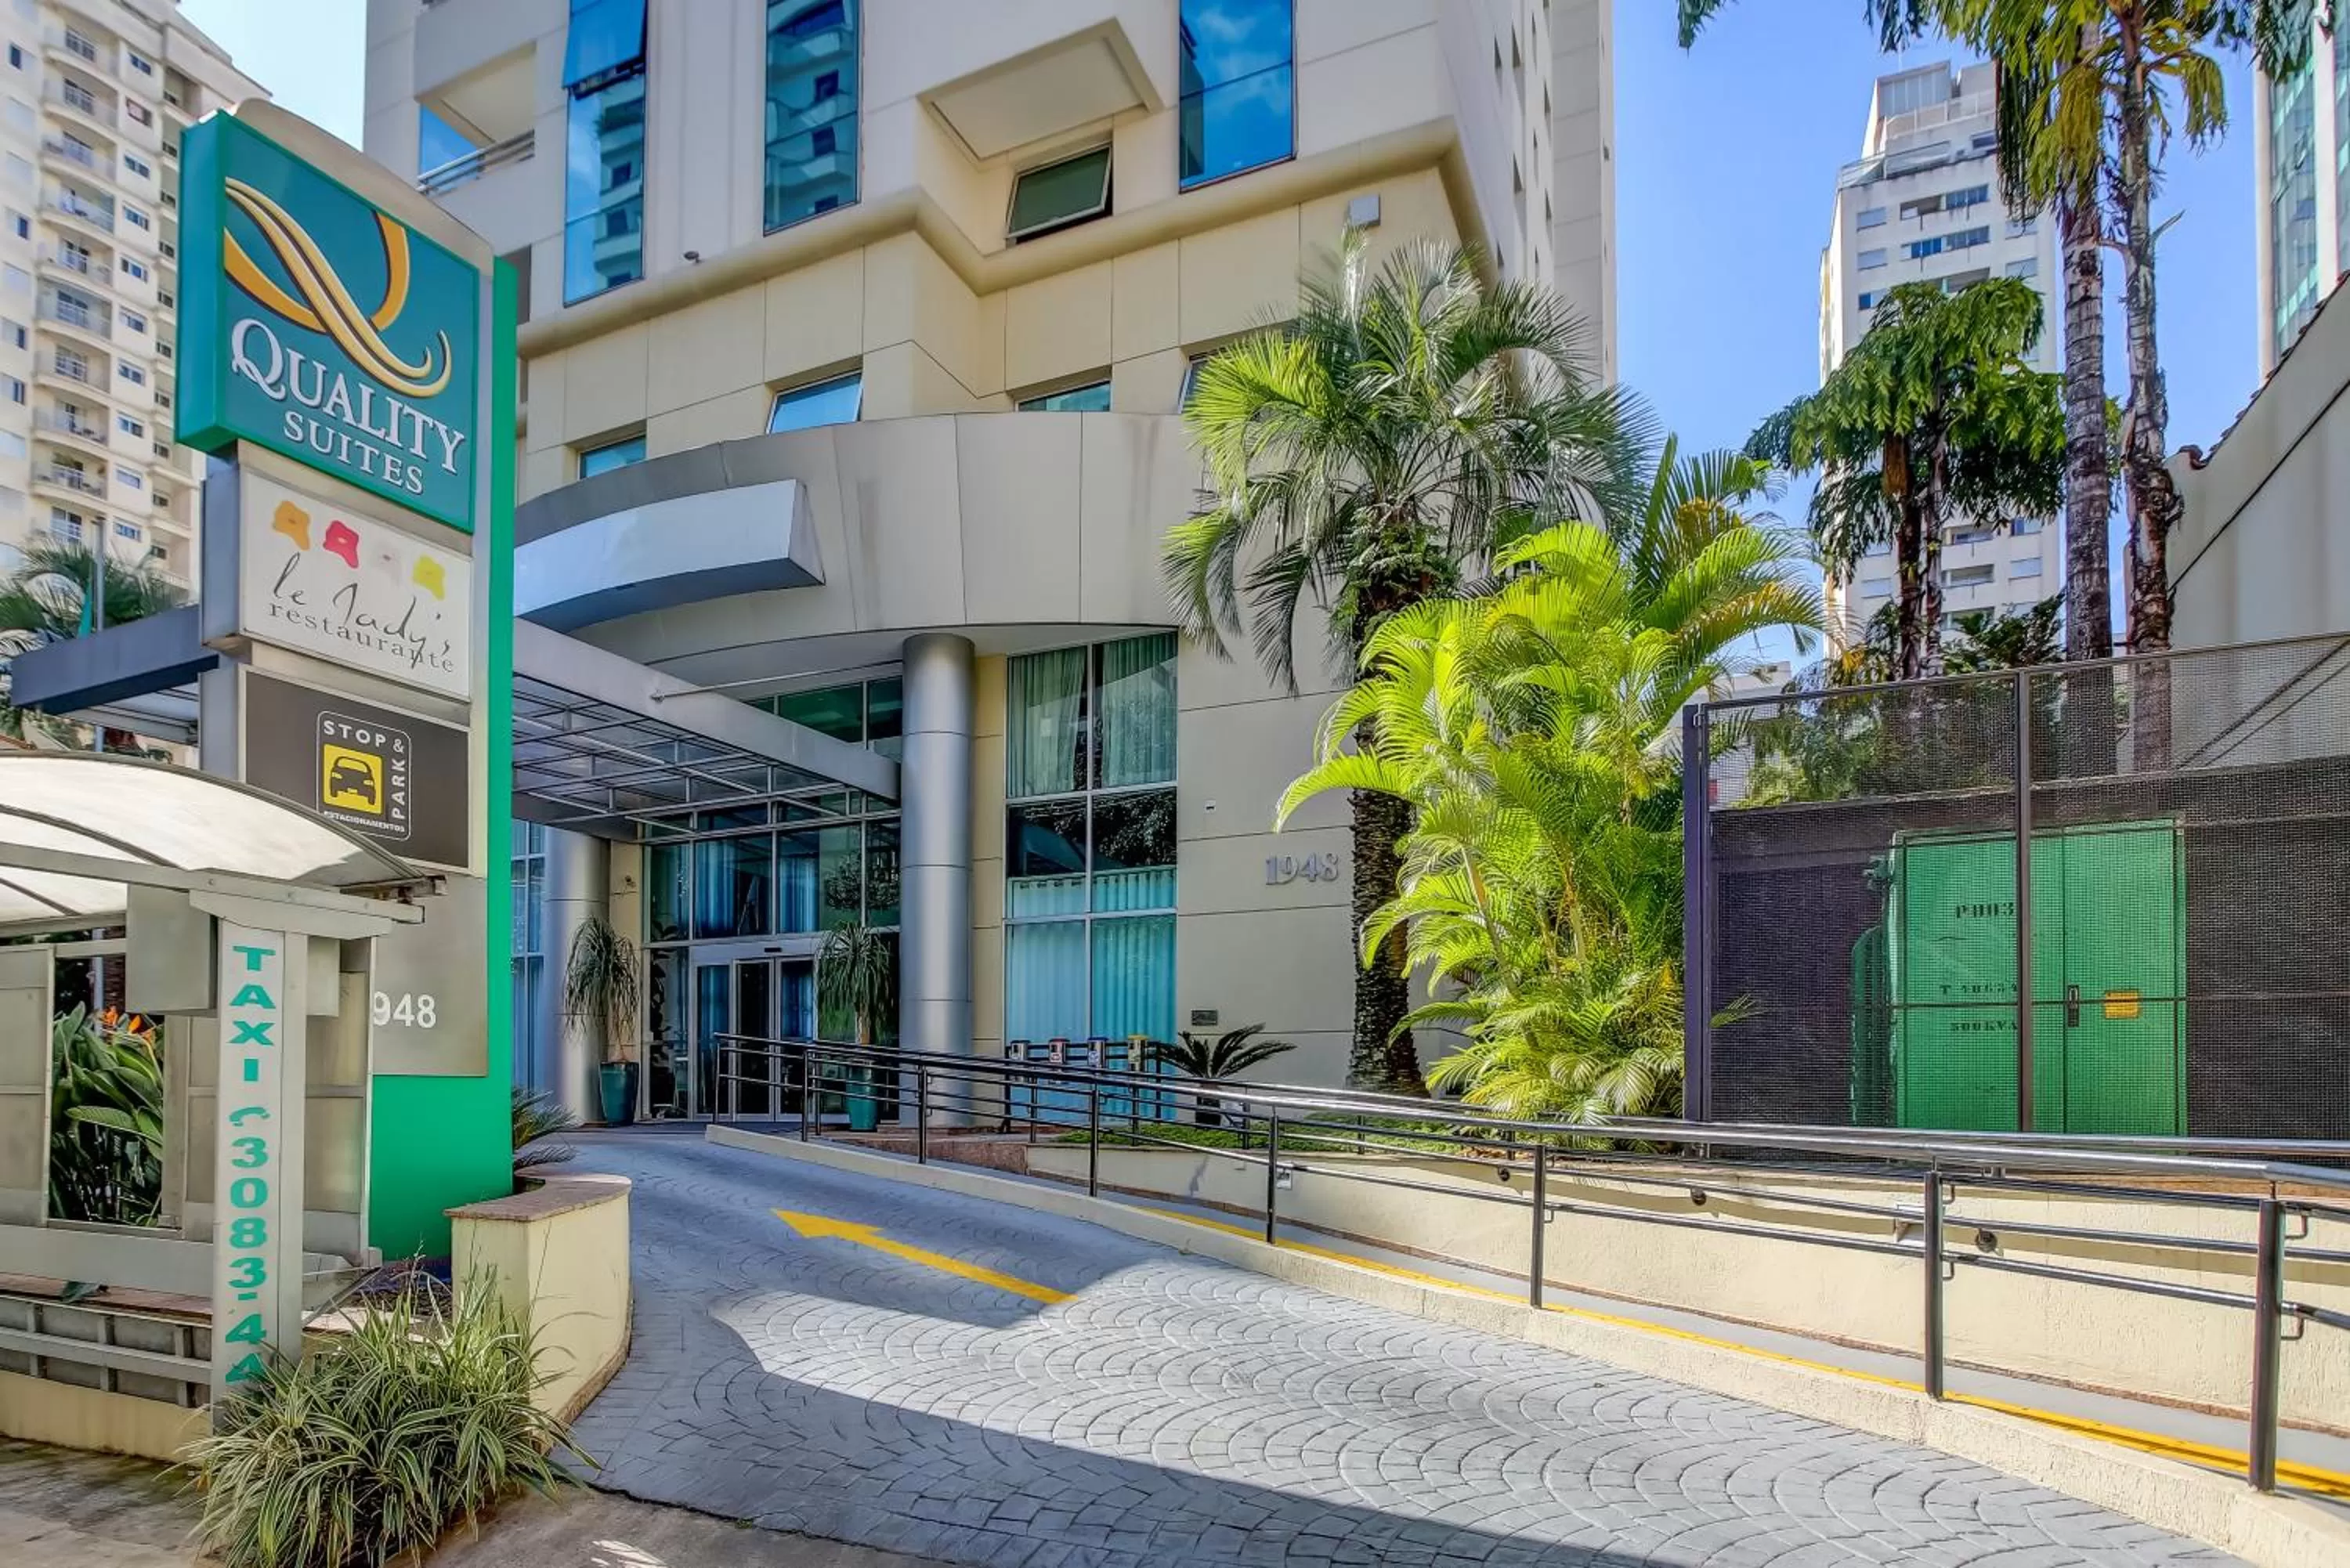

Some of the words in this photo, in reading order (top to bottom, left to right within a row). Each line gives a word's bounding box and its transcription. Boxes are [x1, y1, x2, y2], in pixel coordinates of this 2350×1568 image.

[231, 317, 465, 476] QUALITY
[283, 410, 425, 497] SUITES
[269, 602, 454, 674] restaurante
[323, 720, 386, 747] STOP
[392, 739, 405, 753] &
[392, 759, 405, 820] PARK
[1264, 851, 1339, 886] 1948
[226, 945, 277, 1082] TAXI
